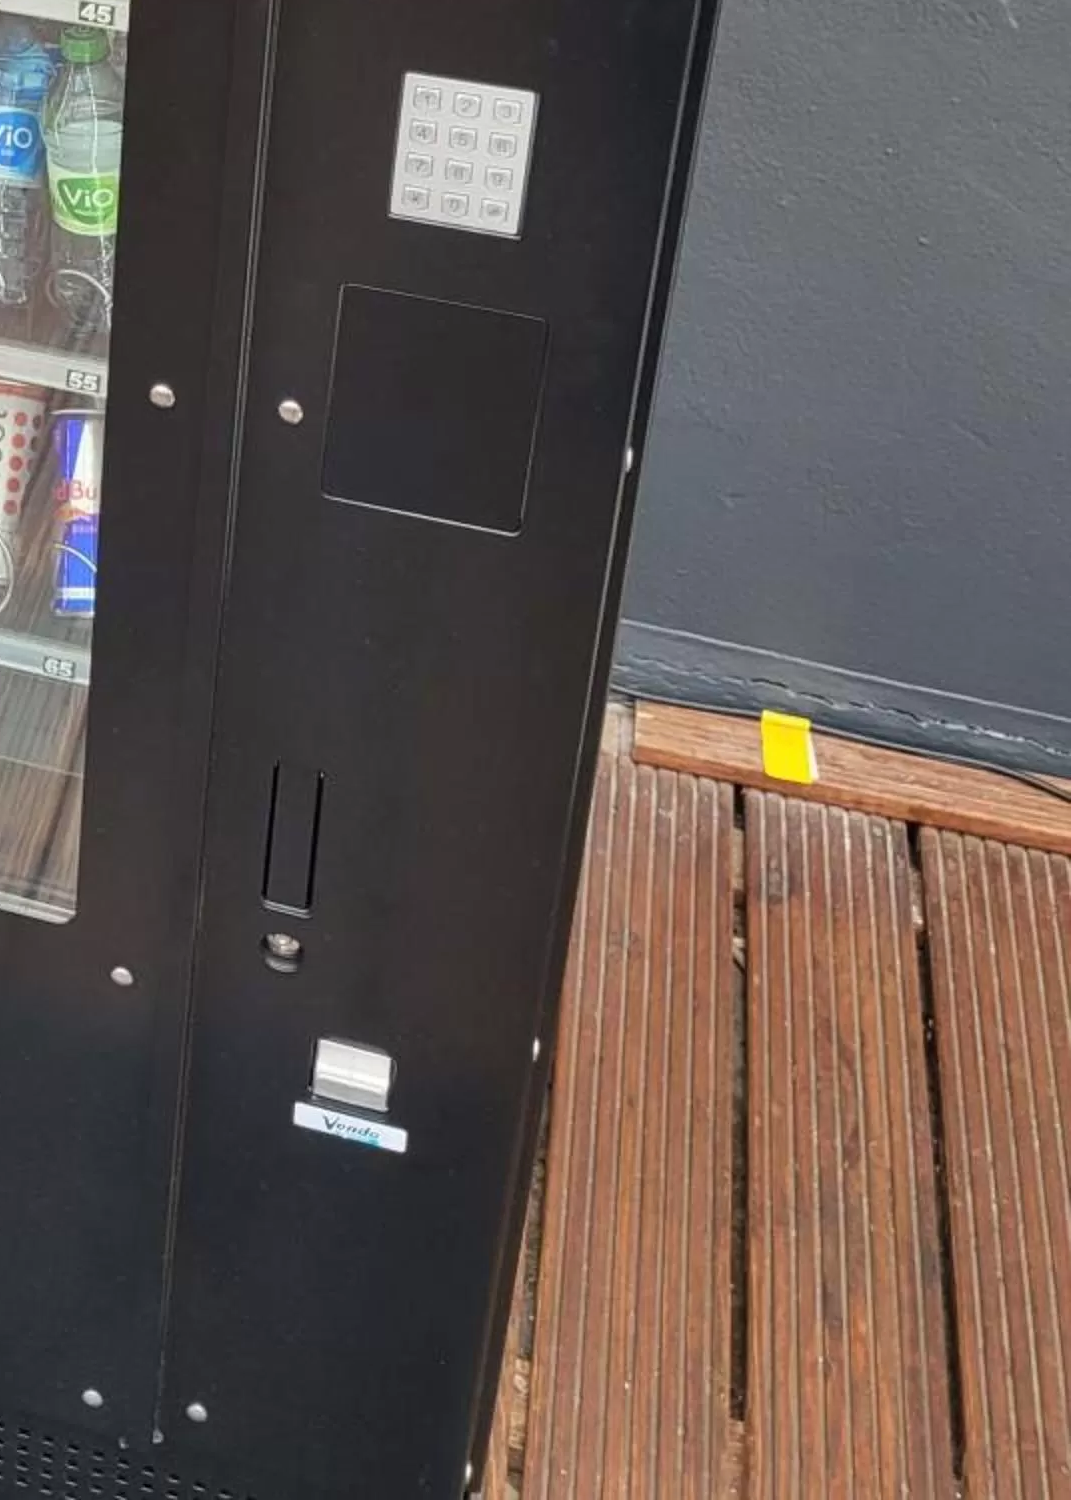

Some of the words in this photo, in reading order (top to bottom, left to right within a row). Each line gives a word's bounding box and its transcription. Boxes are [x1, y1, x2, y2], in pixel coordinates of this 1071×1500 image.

[80, 3, 111, 22] 45
[69, 372, 97, 390] 55
[43, 660, 73, 677] 65
[323, 1113, 380, 1139] Vendo
